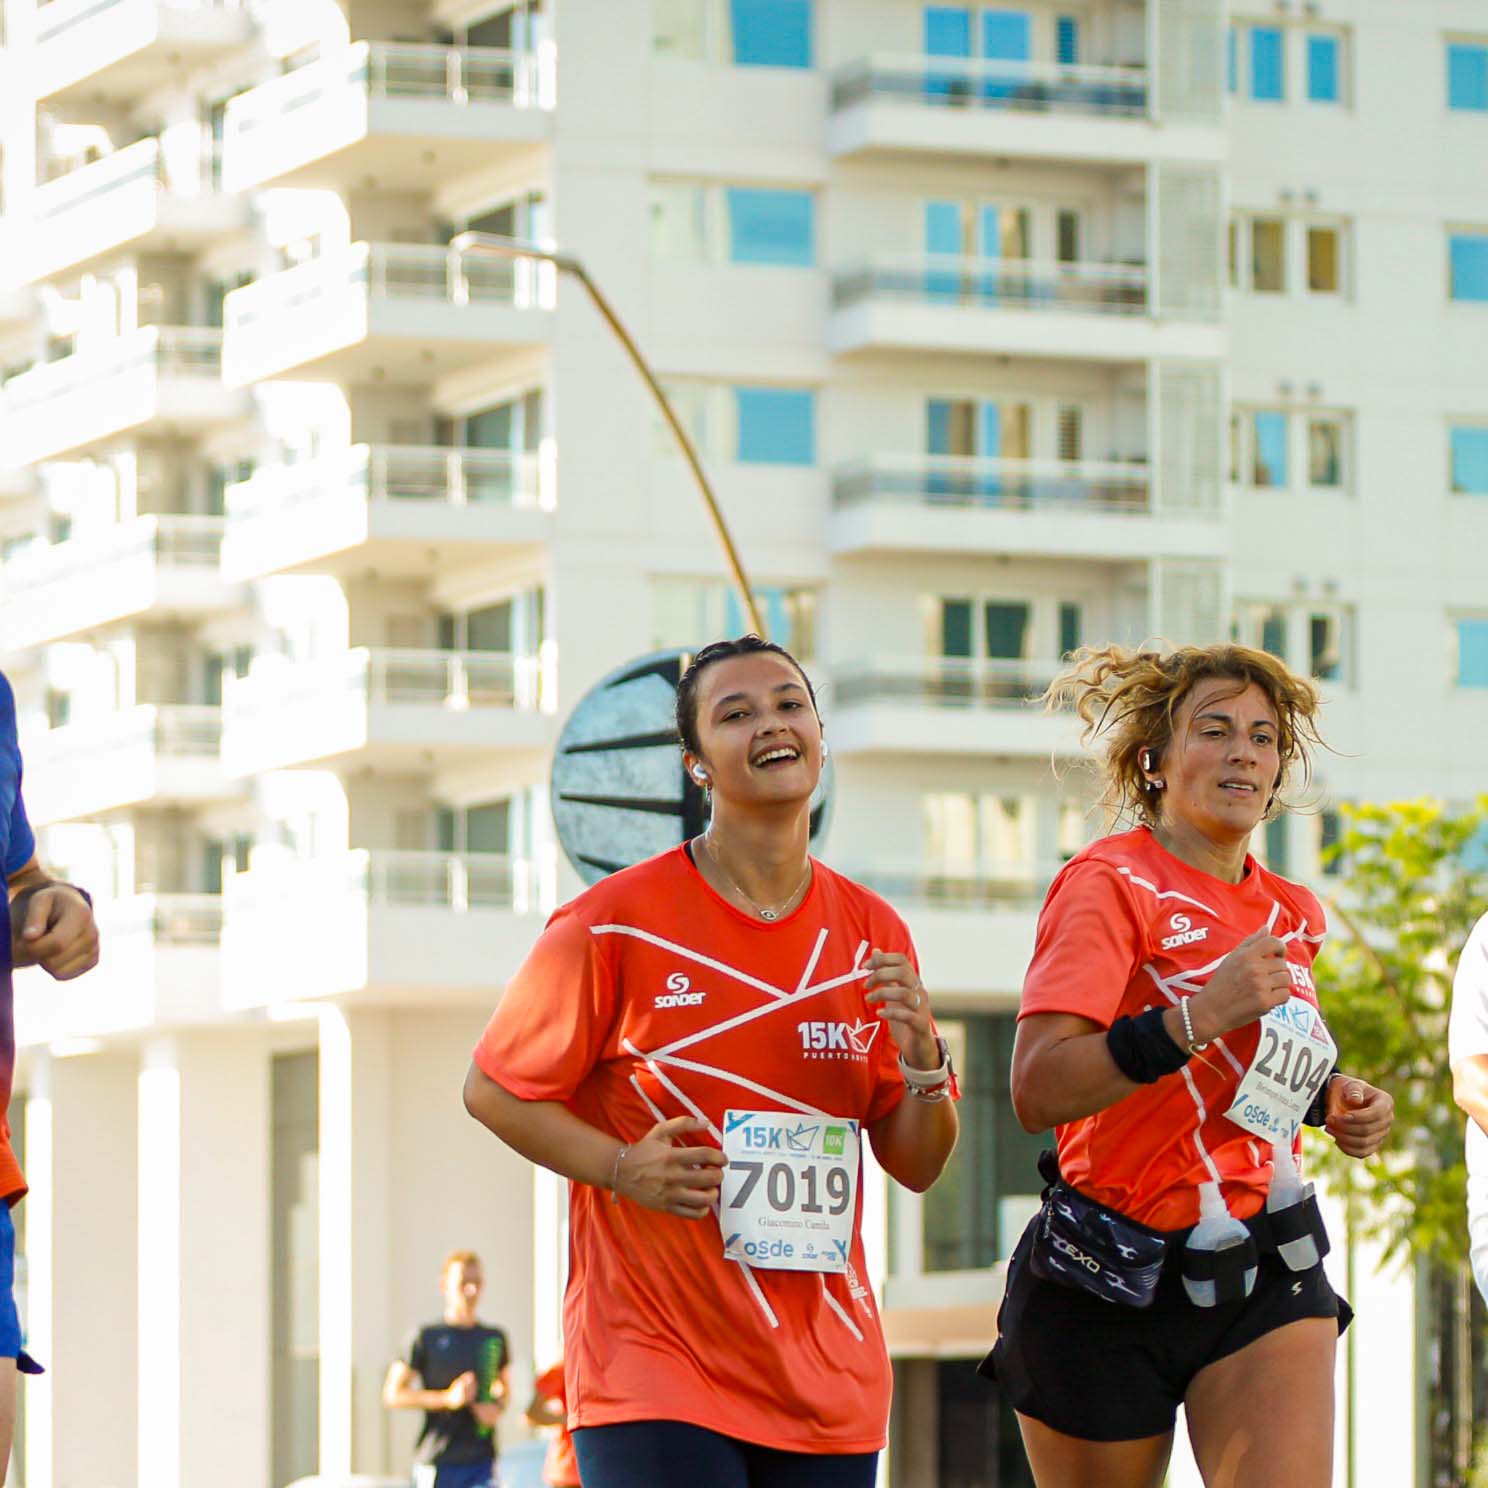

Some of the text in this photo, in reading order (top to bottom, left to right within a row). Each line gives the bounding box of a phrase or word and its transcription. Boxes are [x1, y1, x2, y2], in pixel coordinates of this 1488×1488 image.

[798, 1021, 849, 1049] 15K
[803, 1051, 849, 1060] PUERTO
[1255, 1027, 1329, 1100] 2104
[742, 1126, 783, 1149] 15K
[729, 1160, 850, 1216] 7019
[1065, 1243, 1101, 1274] EXO
